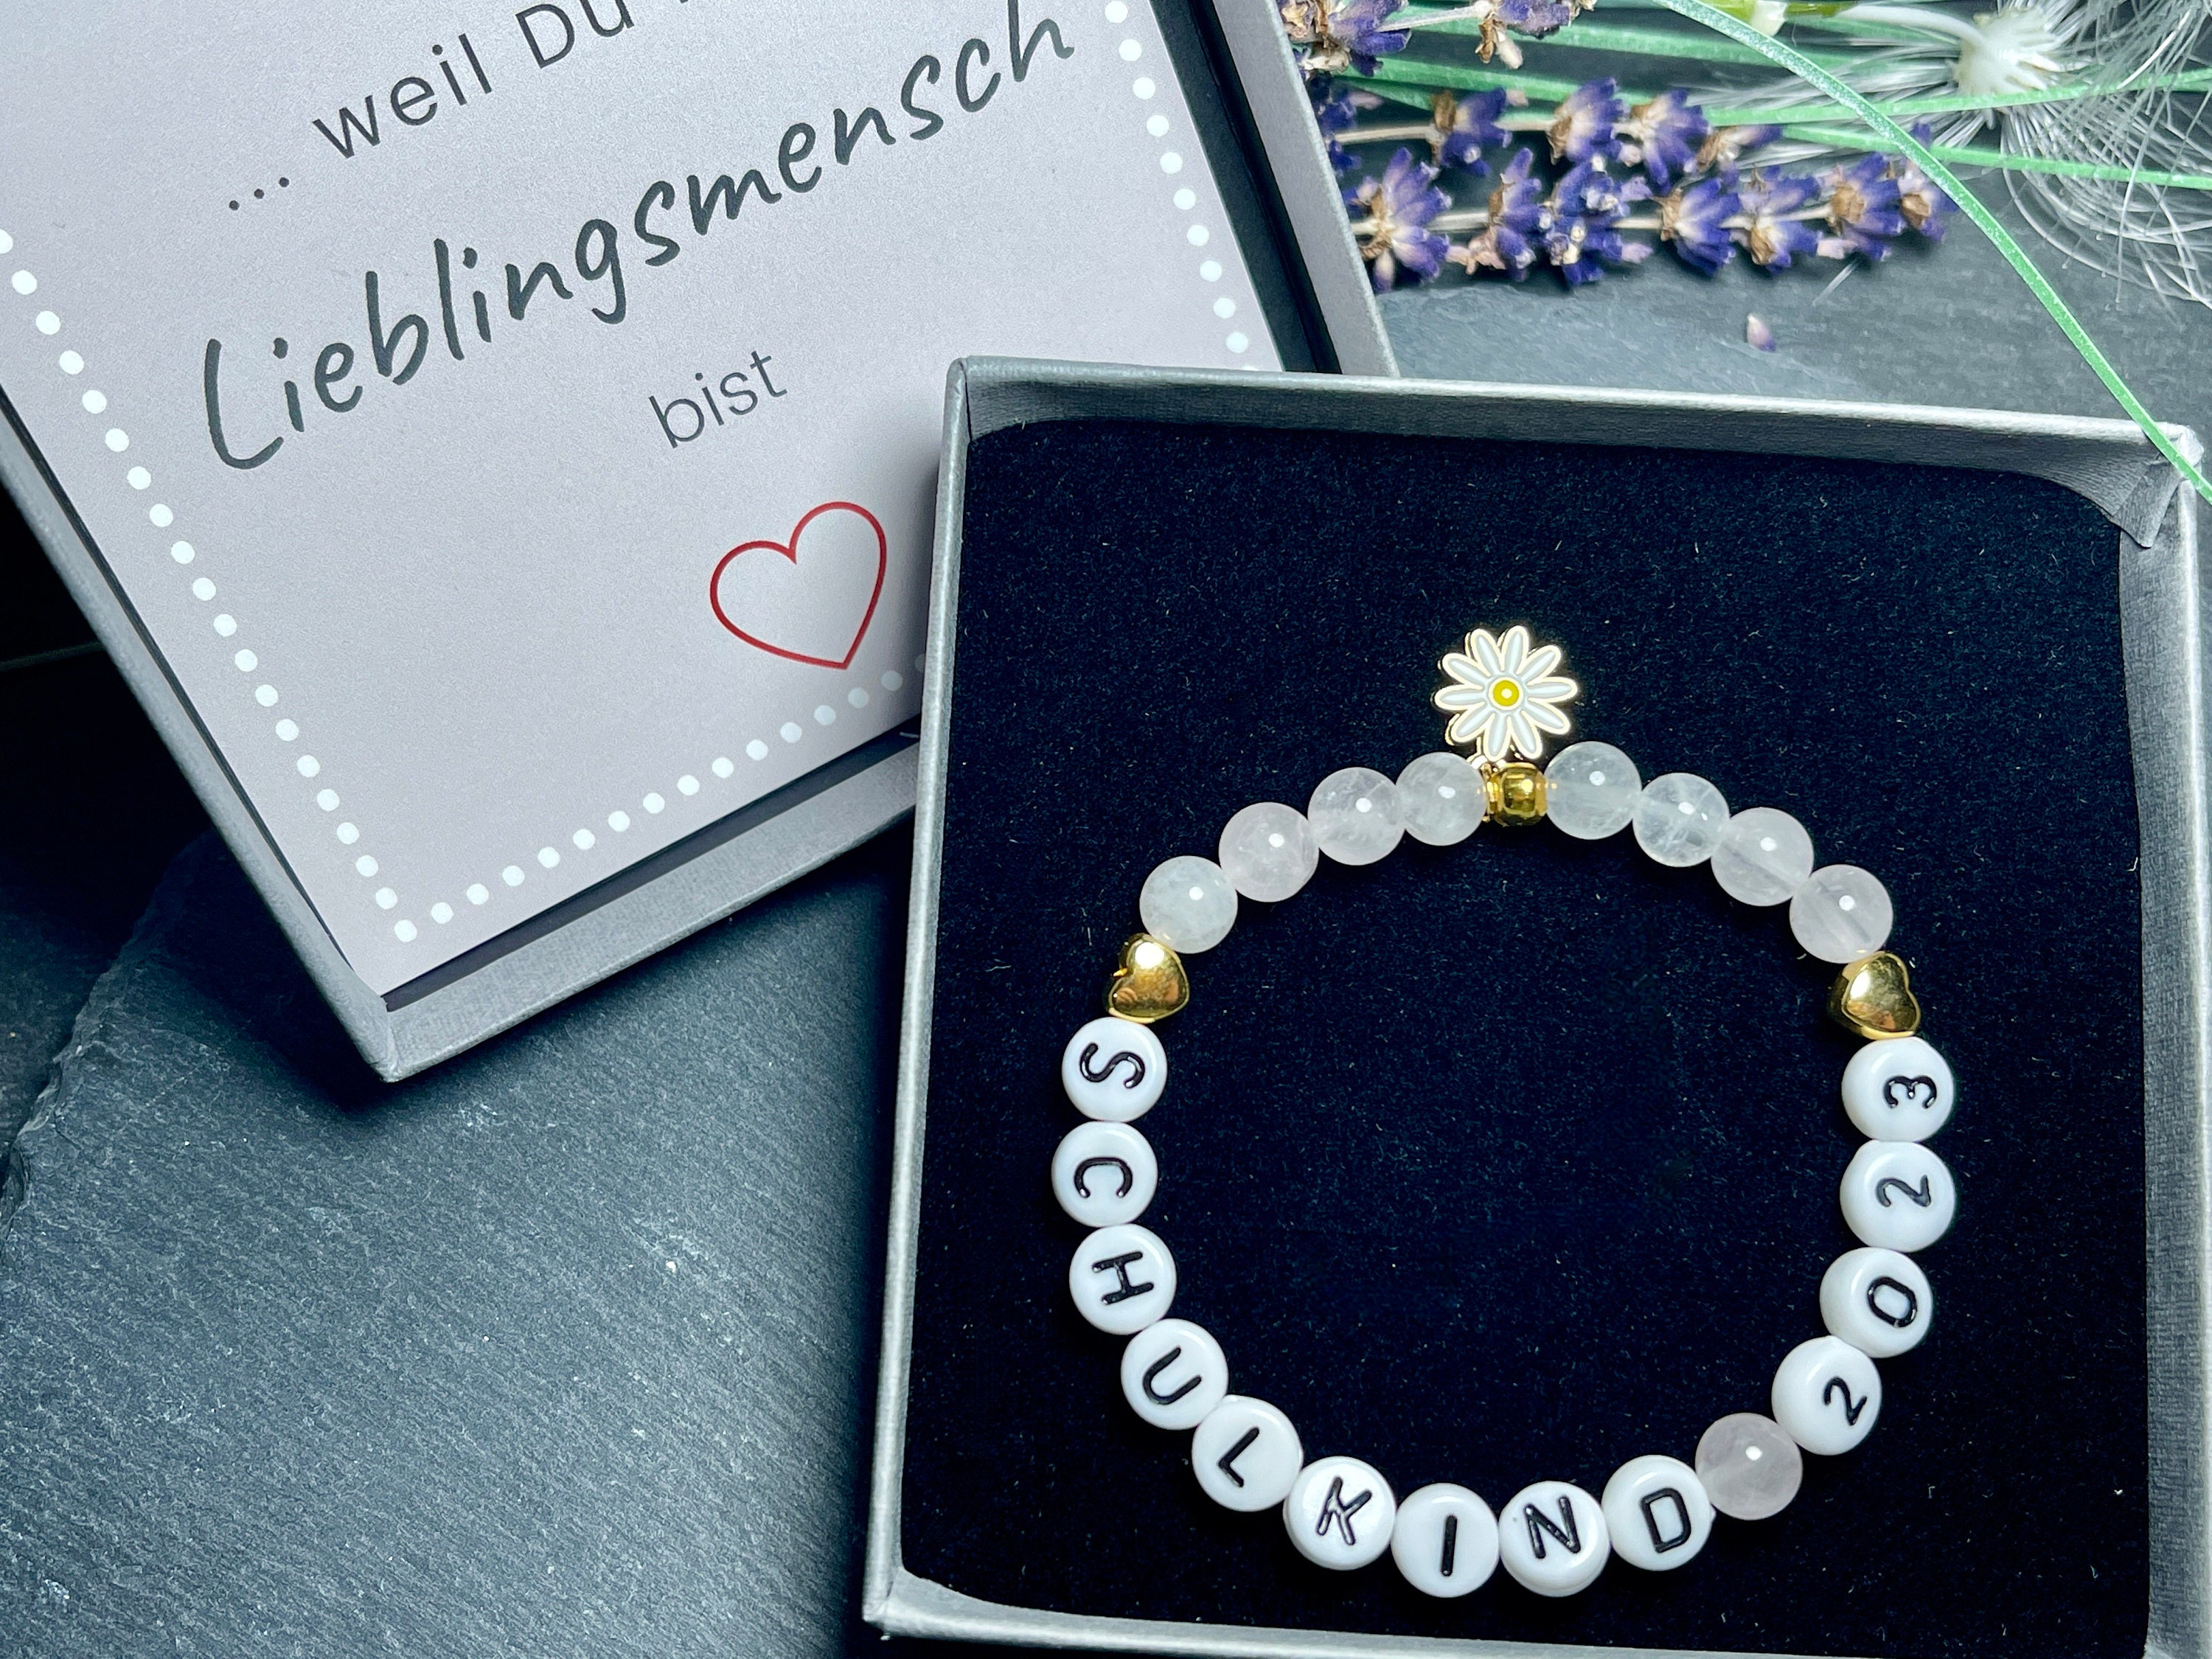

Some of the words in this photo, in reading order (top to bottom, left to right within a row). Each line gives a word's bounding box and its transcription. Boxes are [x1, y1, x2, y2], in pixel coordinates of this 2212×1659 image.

[204, 0, 1074, 470] Lieblingsmensch
[312, 34, 492, 159] weil
[515, 0, 634, 69] Du
[649, 351, 787, 448] bist
[1073, 1043, 1692, 1577] SCHULKIND
[1823, 1075, 1938, 1426] 2023
